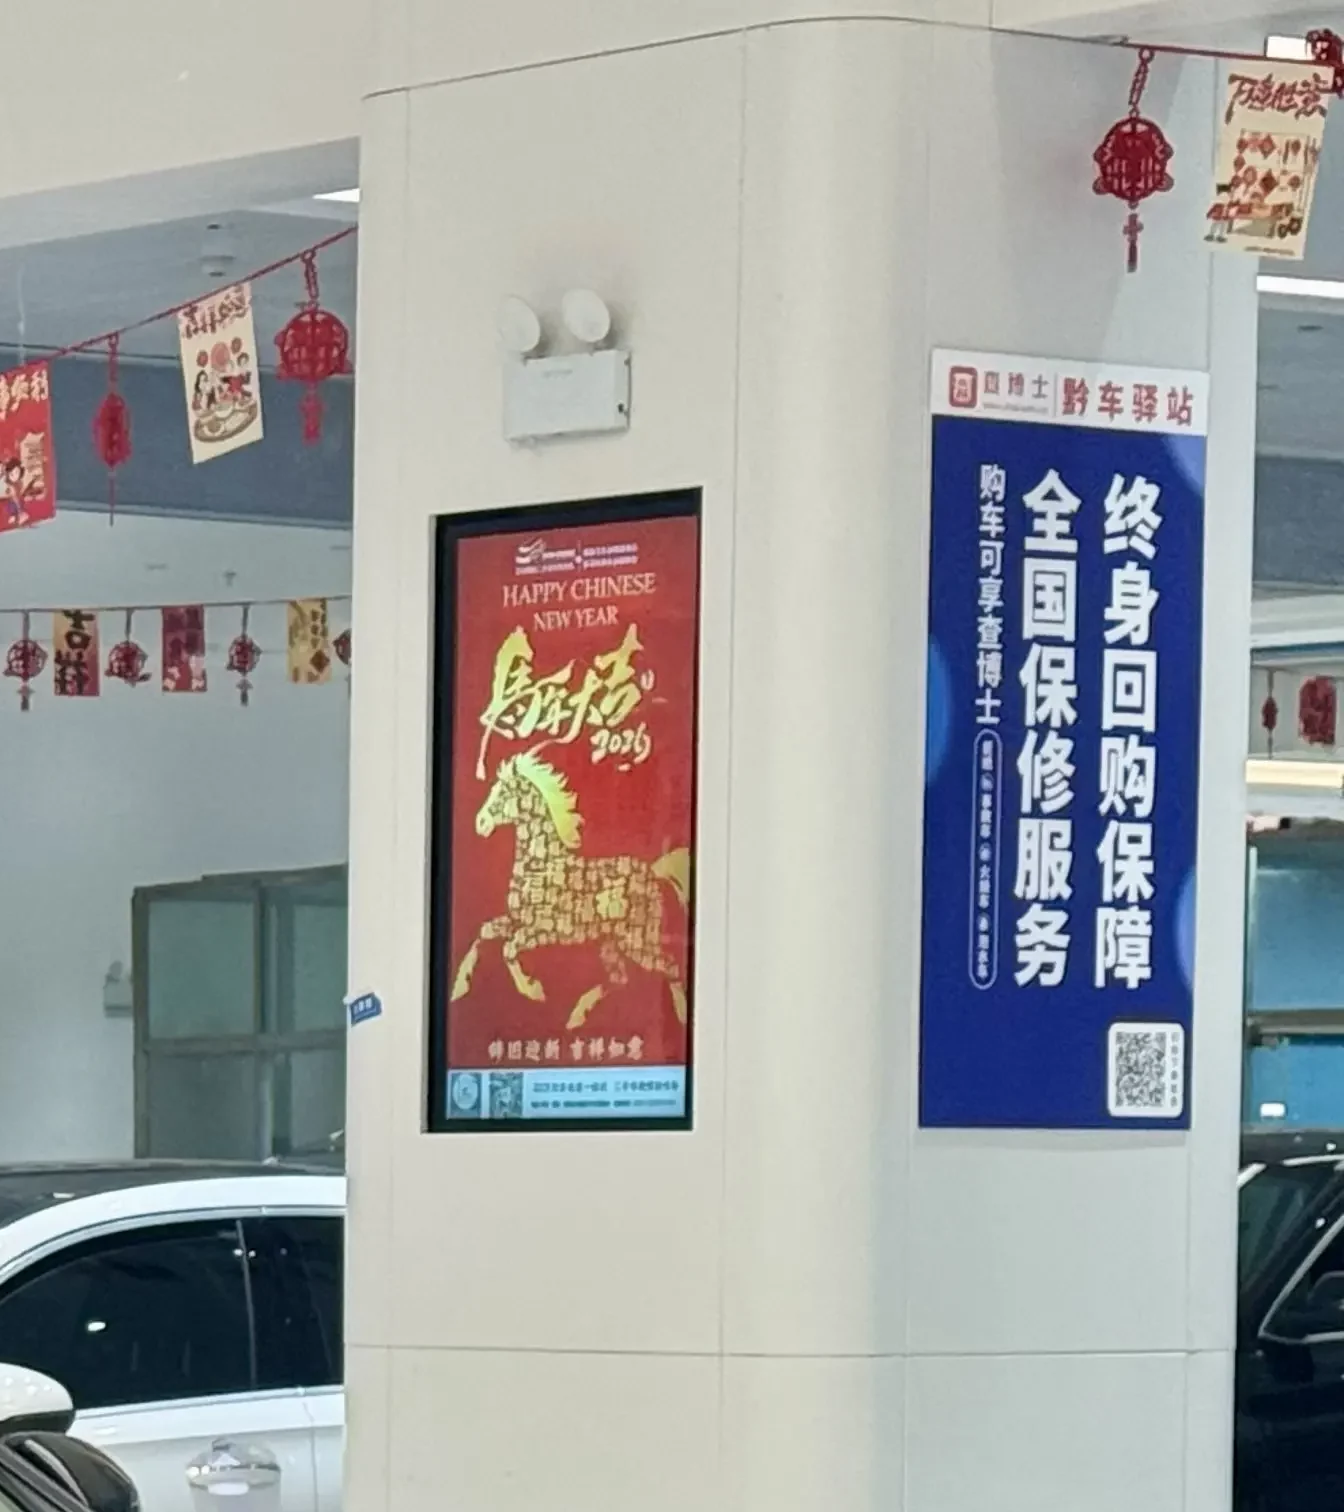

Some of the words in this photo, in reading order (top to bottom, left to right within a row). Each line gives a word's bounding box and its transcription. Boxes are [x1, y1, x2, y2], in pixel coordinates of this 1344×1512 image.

[1063, 377, 1194, 427] 黔车驿站
[503, 581, 568, 608] HAPPY
[570, 572, 656, 601] CHINESE
[533, 610, 572, 632] NEW
[574, 605, 618, 629] YEAR
[974, 463, 1007, 726] 购车可享查博士
[1013, 468, 1082, 988] 全国保修服务
[1094, 474, 1162, 990] 终身回购保障
